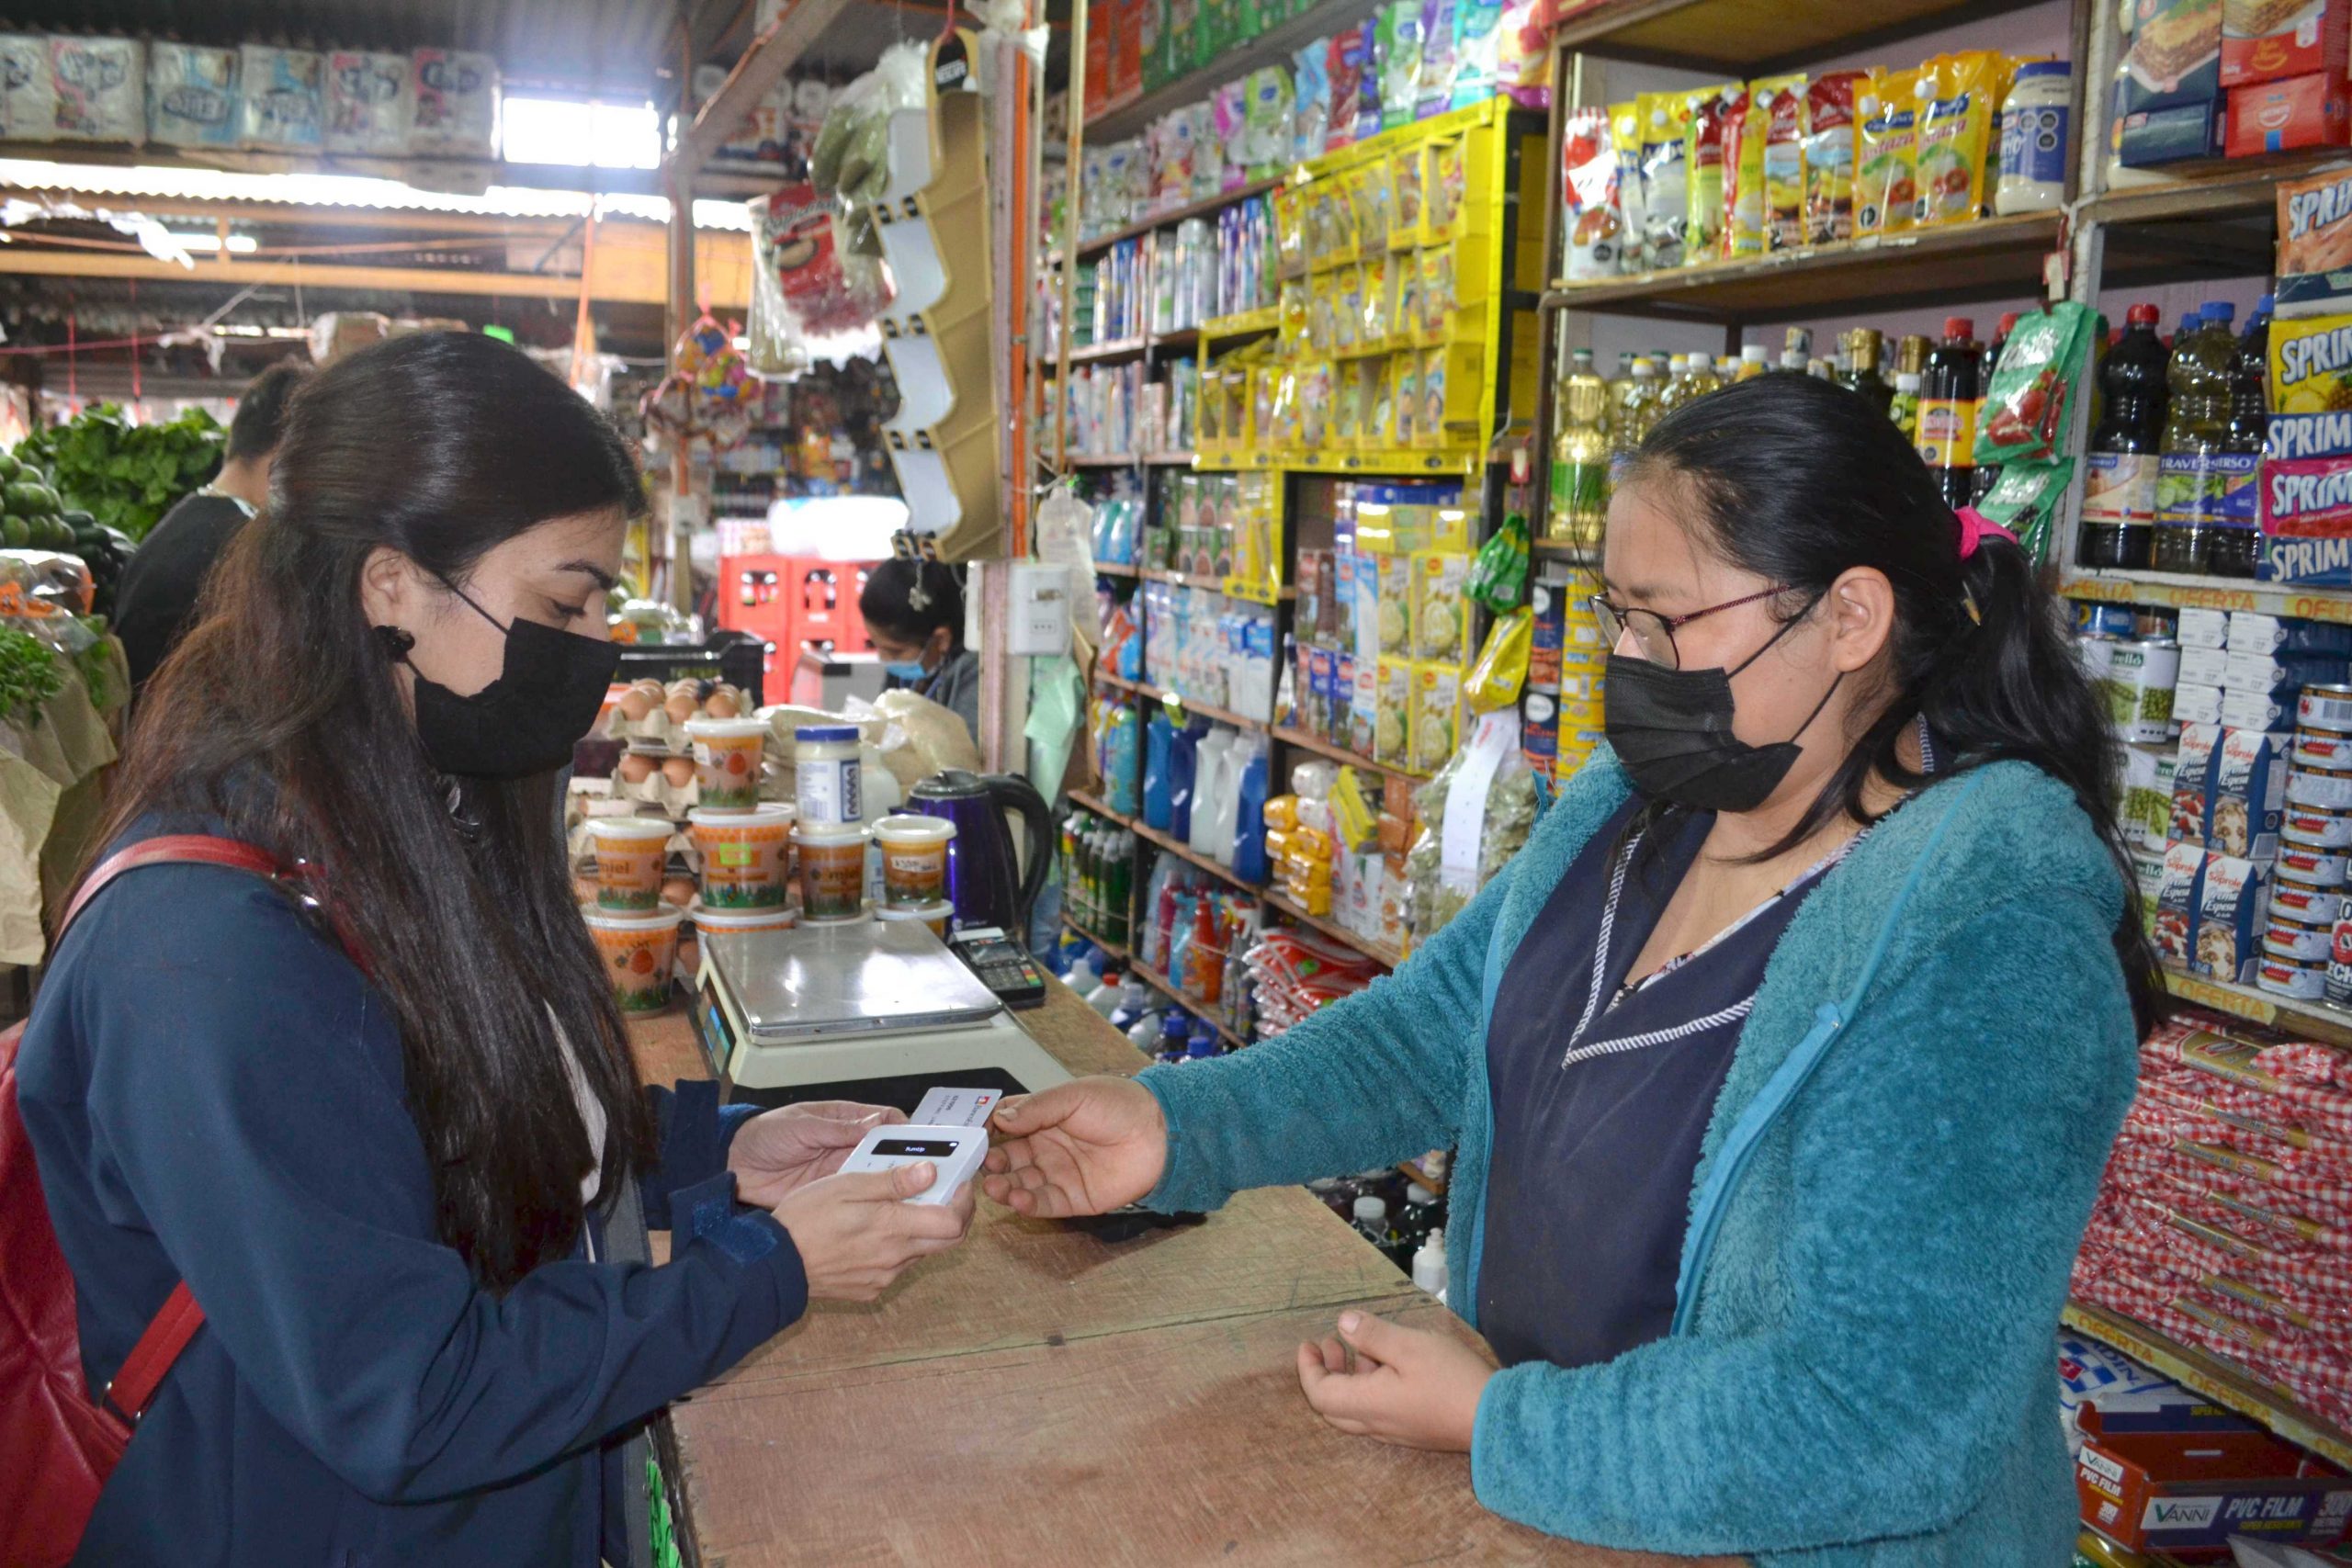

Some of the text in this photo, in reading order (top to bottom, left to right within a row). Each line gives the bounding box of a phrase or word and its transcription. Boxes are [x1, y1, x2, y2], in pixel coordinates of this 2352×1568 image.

[2267, 413, 2352, 459] SPRIM
[2271, 537, 2349, 582] SPRIM
[2169, 588, 2256, 612] OFERTA
[2165, 858, 2196, 874] Soprole
[2208, 871, 2243, 887] Soprole
[2163, 887, 2190, 900] Espesa
[2205, 900, 2237, 916] Espesa
[2177, 979, 2265, 1017] OFERTA
[2078, 1314, 2154, 1362] OFERTA
[2086, 1451, 2119, 1478] VANNI
[2080, 1467, 2100, 1484] PVC
[2098, 1477, 2122, 1497] FILM
[2154, 1503, 2211, 1523] VANNI
[2224, 1496, 2305, 1518] PVC FILM
